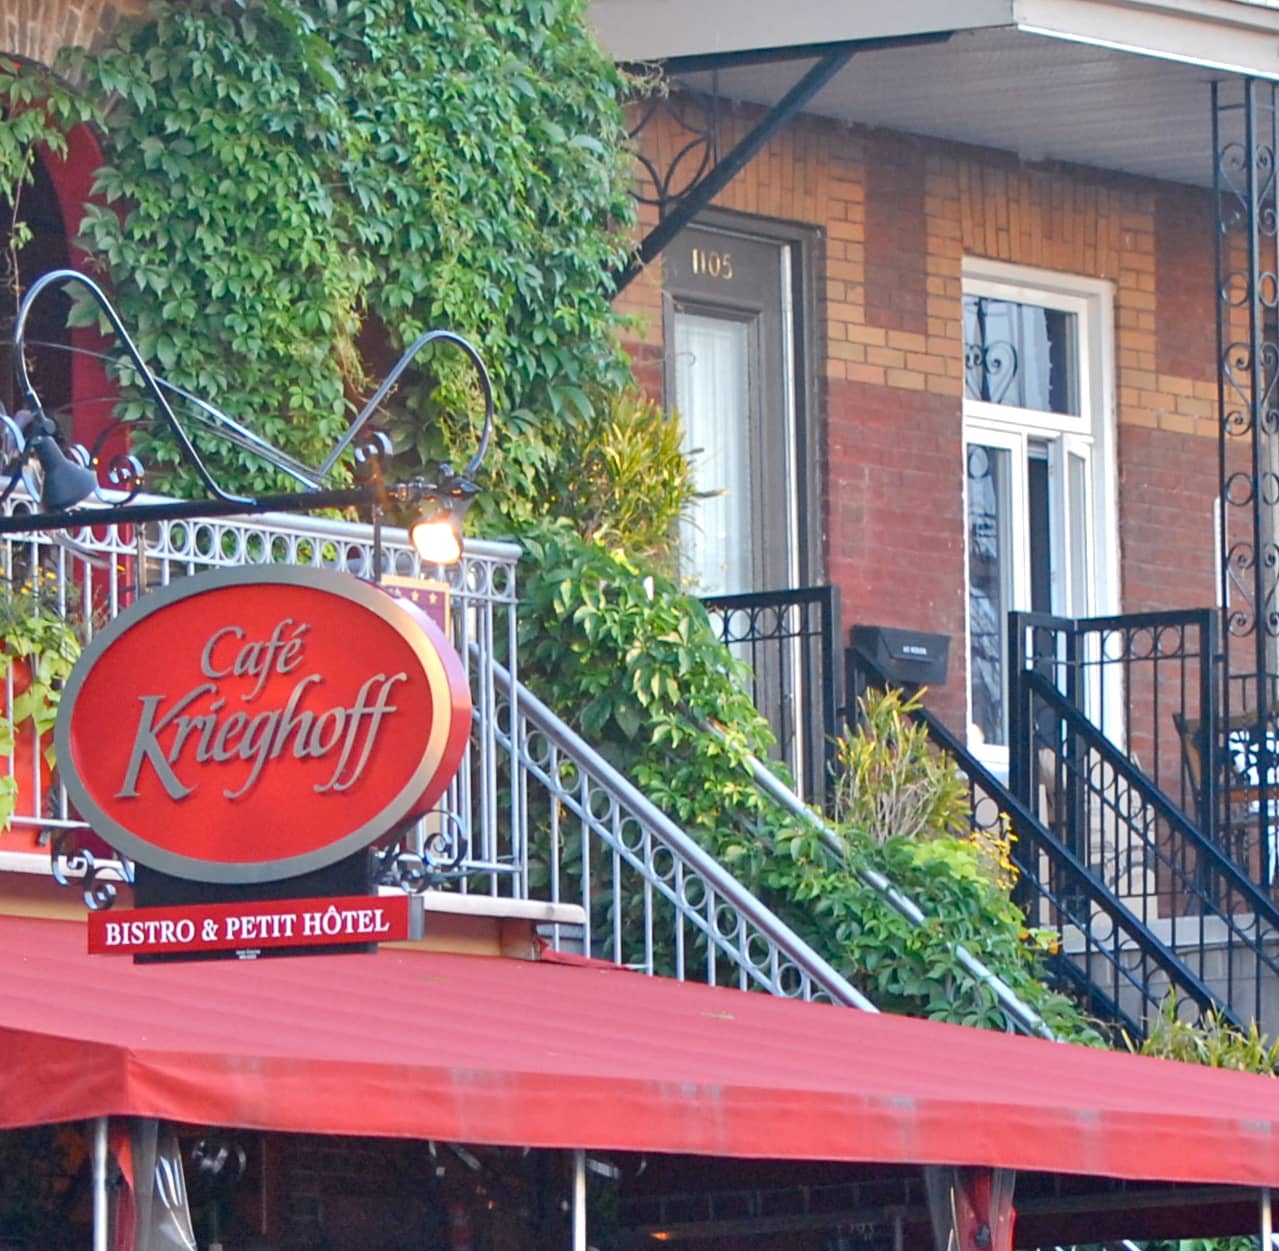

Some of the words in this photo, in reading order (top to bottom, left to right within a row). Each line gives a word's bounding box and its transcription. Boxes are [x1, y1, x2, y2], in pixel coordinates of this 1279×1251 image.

[692, 248, 733, 280] 1105
[200, 619, 310, 700] Café
[113, 673, 408, 801] Krieghoff
[104, 919, 195, 946] BISTRO
[201, 918, 219, 941] &
[225, 913, 297, 940] PETIT
[303, 905, 390, 936] HÔTEL
